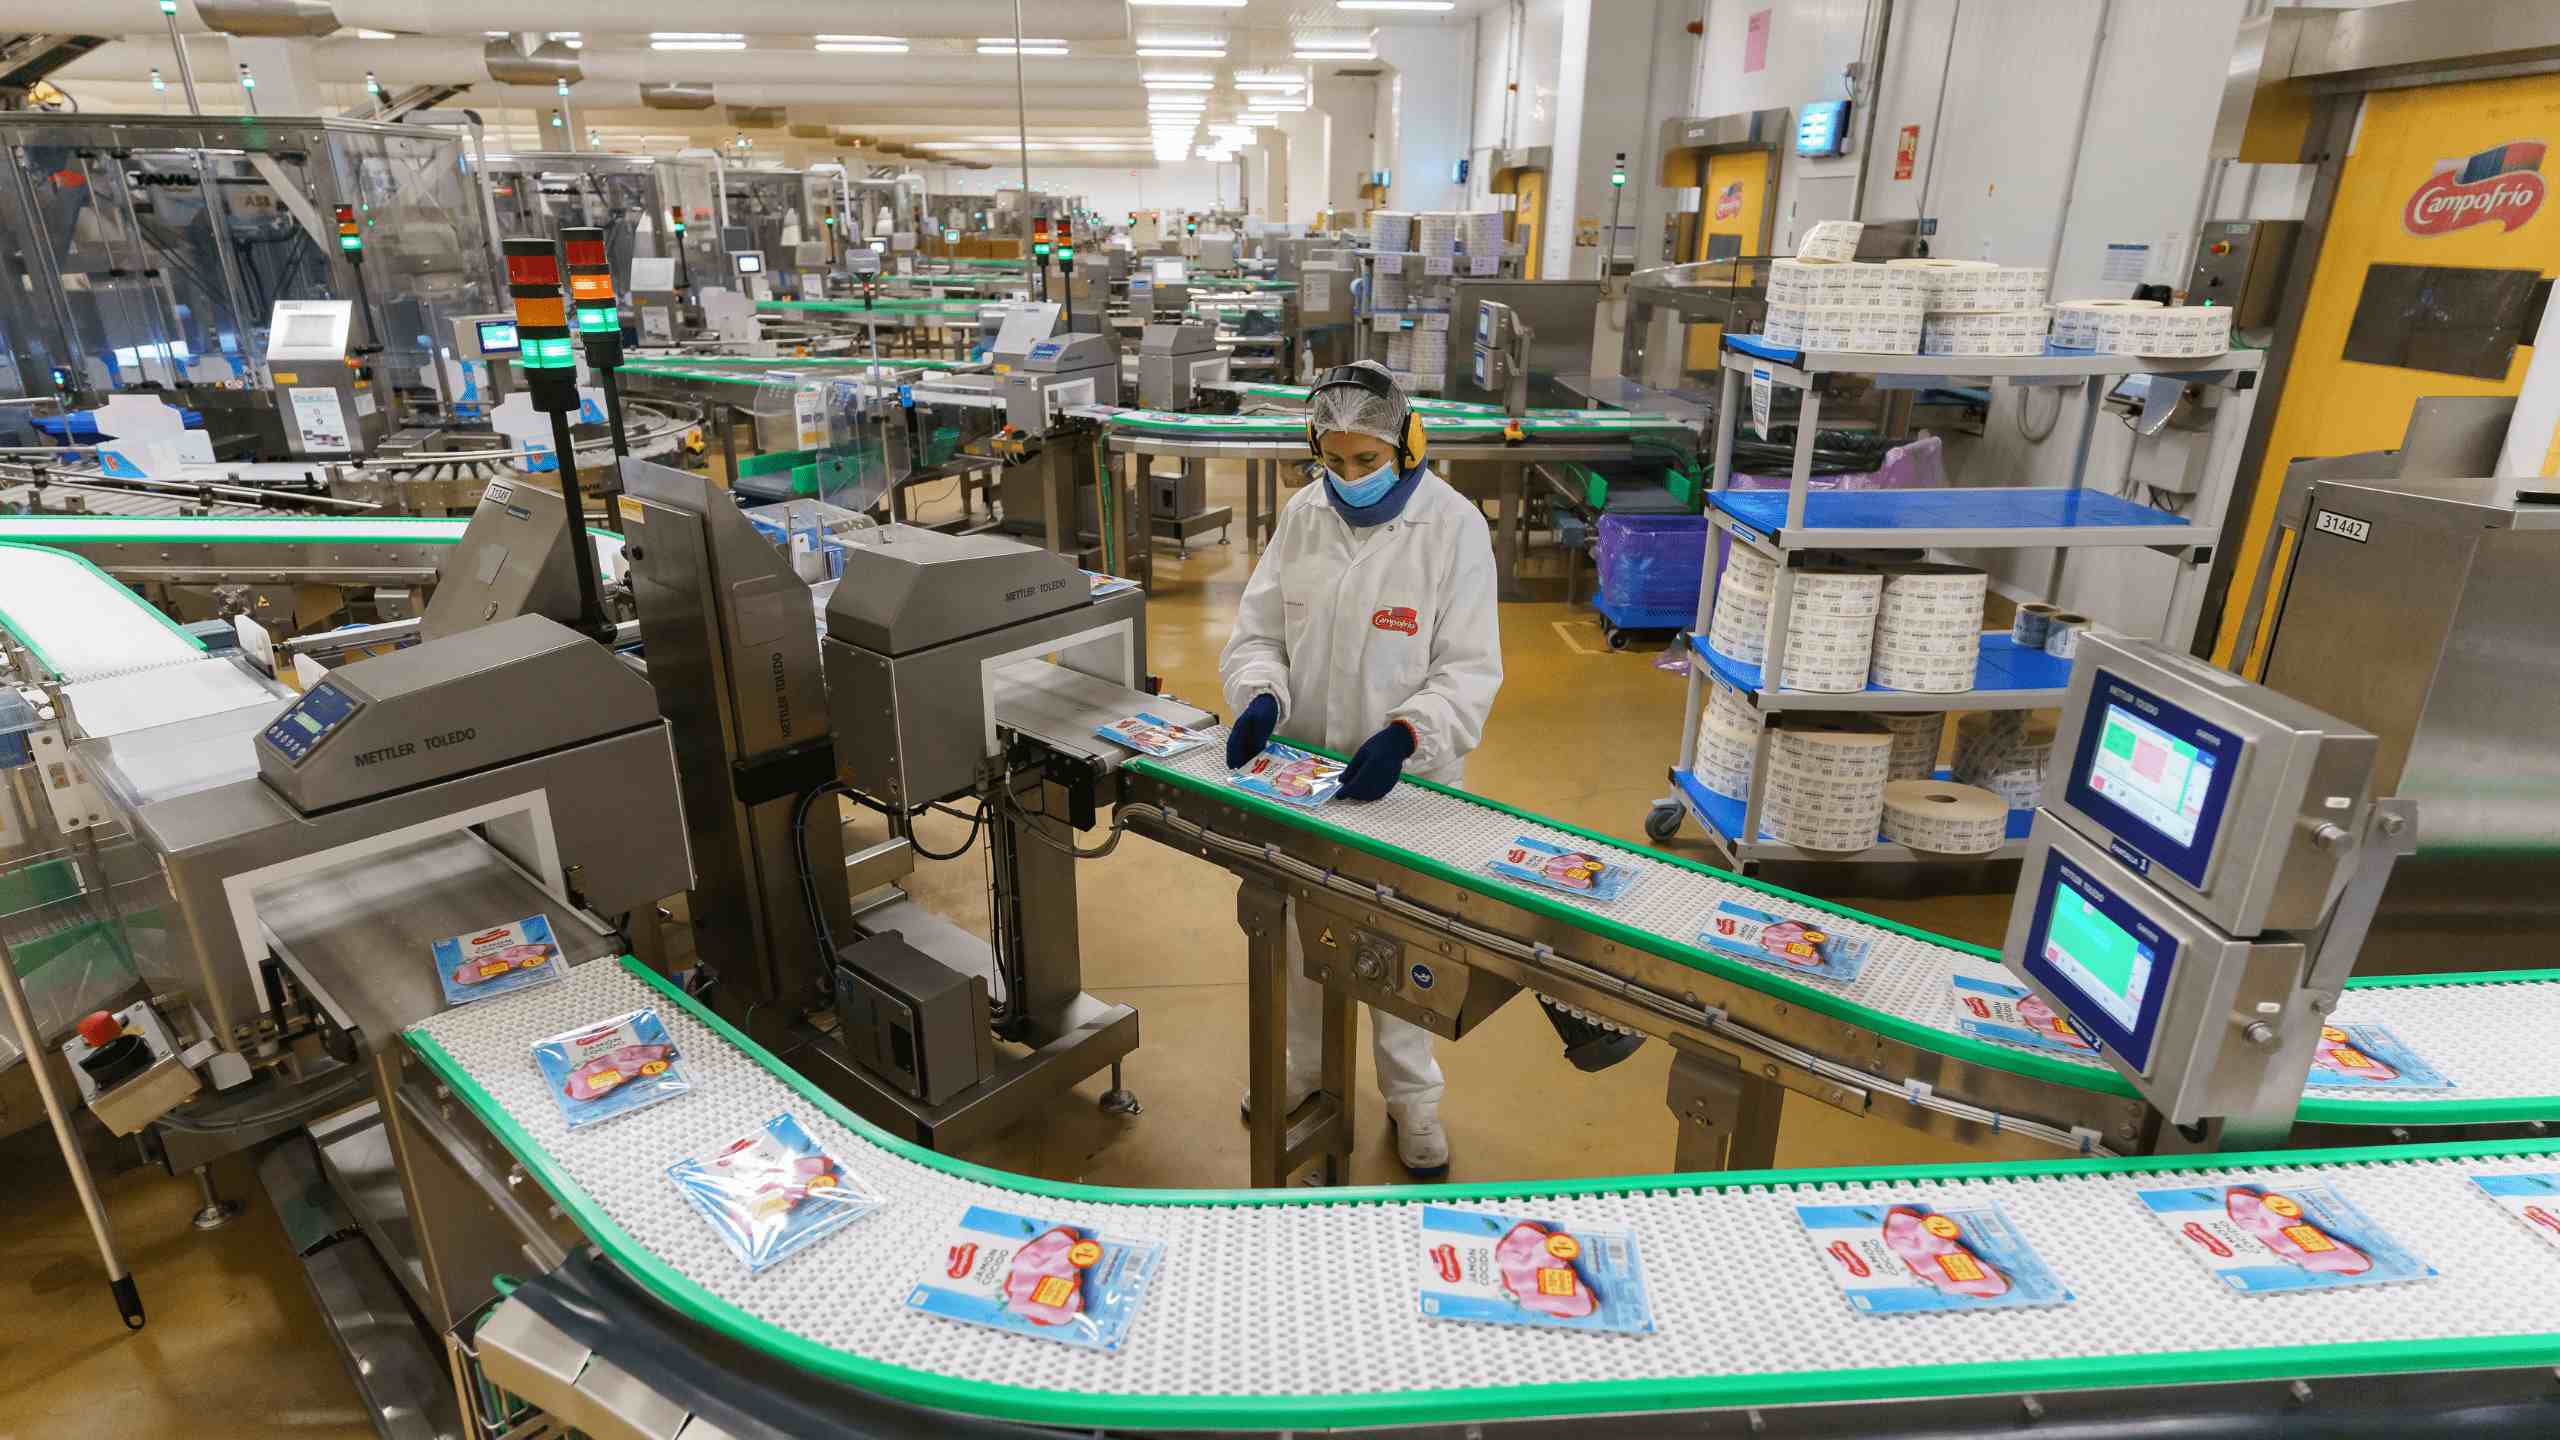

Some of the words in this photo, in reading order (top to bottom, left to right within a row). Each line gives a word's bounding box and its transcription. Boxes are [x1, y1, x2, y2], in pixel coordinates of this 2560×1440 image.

[2323, 514, 2362, 537] 31442
[1040, 578, 1066, 593] TOLEDO
[353, 742, 416, 768] METTLER
[424, 727, 477, 751] TOLEDO
[981, 1249, 1009, 1286] COCIDO
[1479, 1247, 1490, 1287] COCIDO
